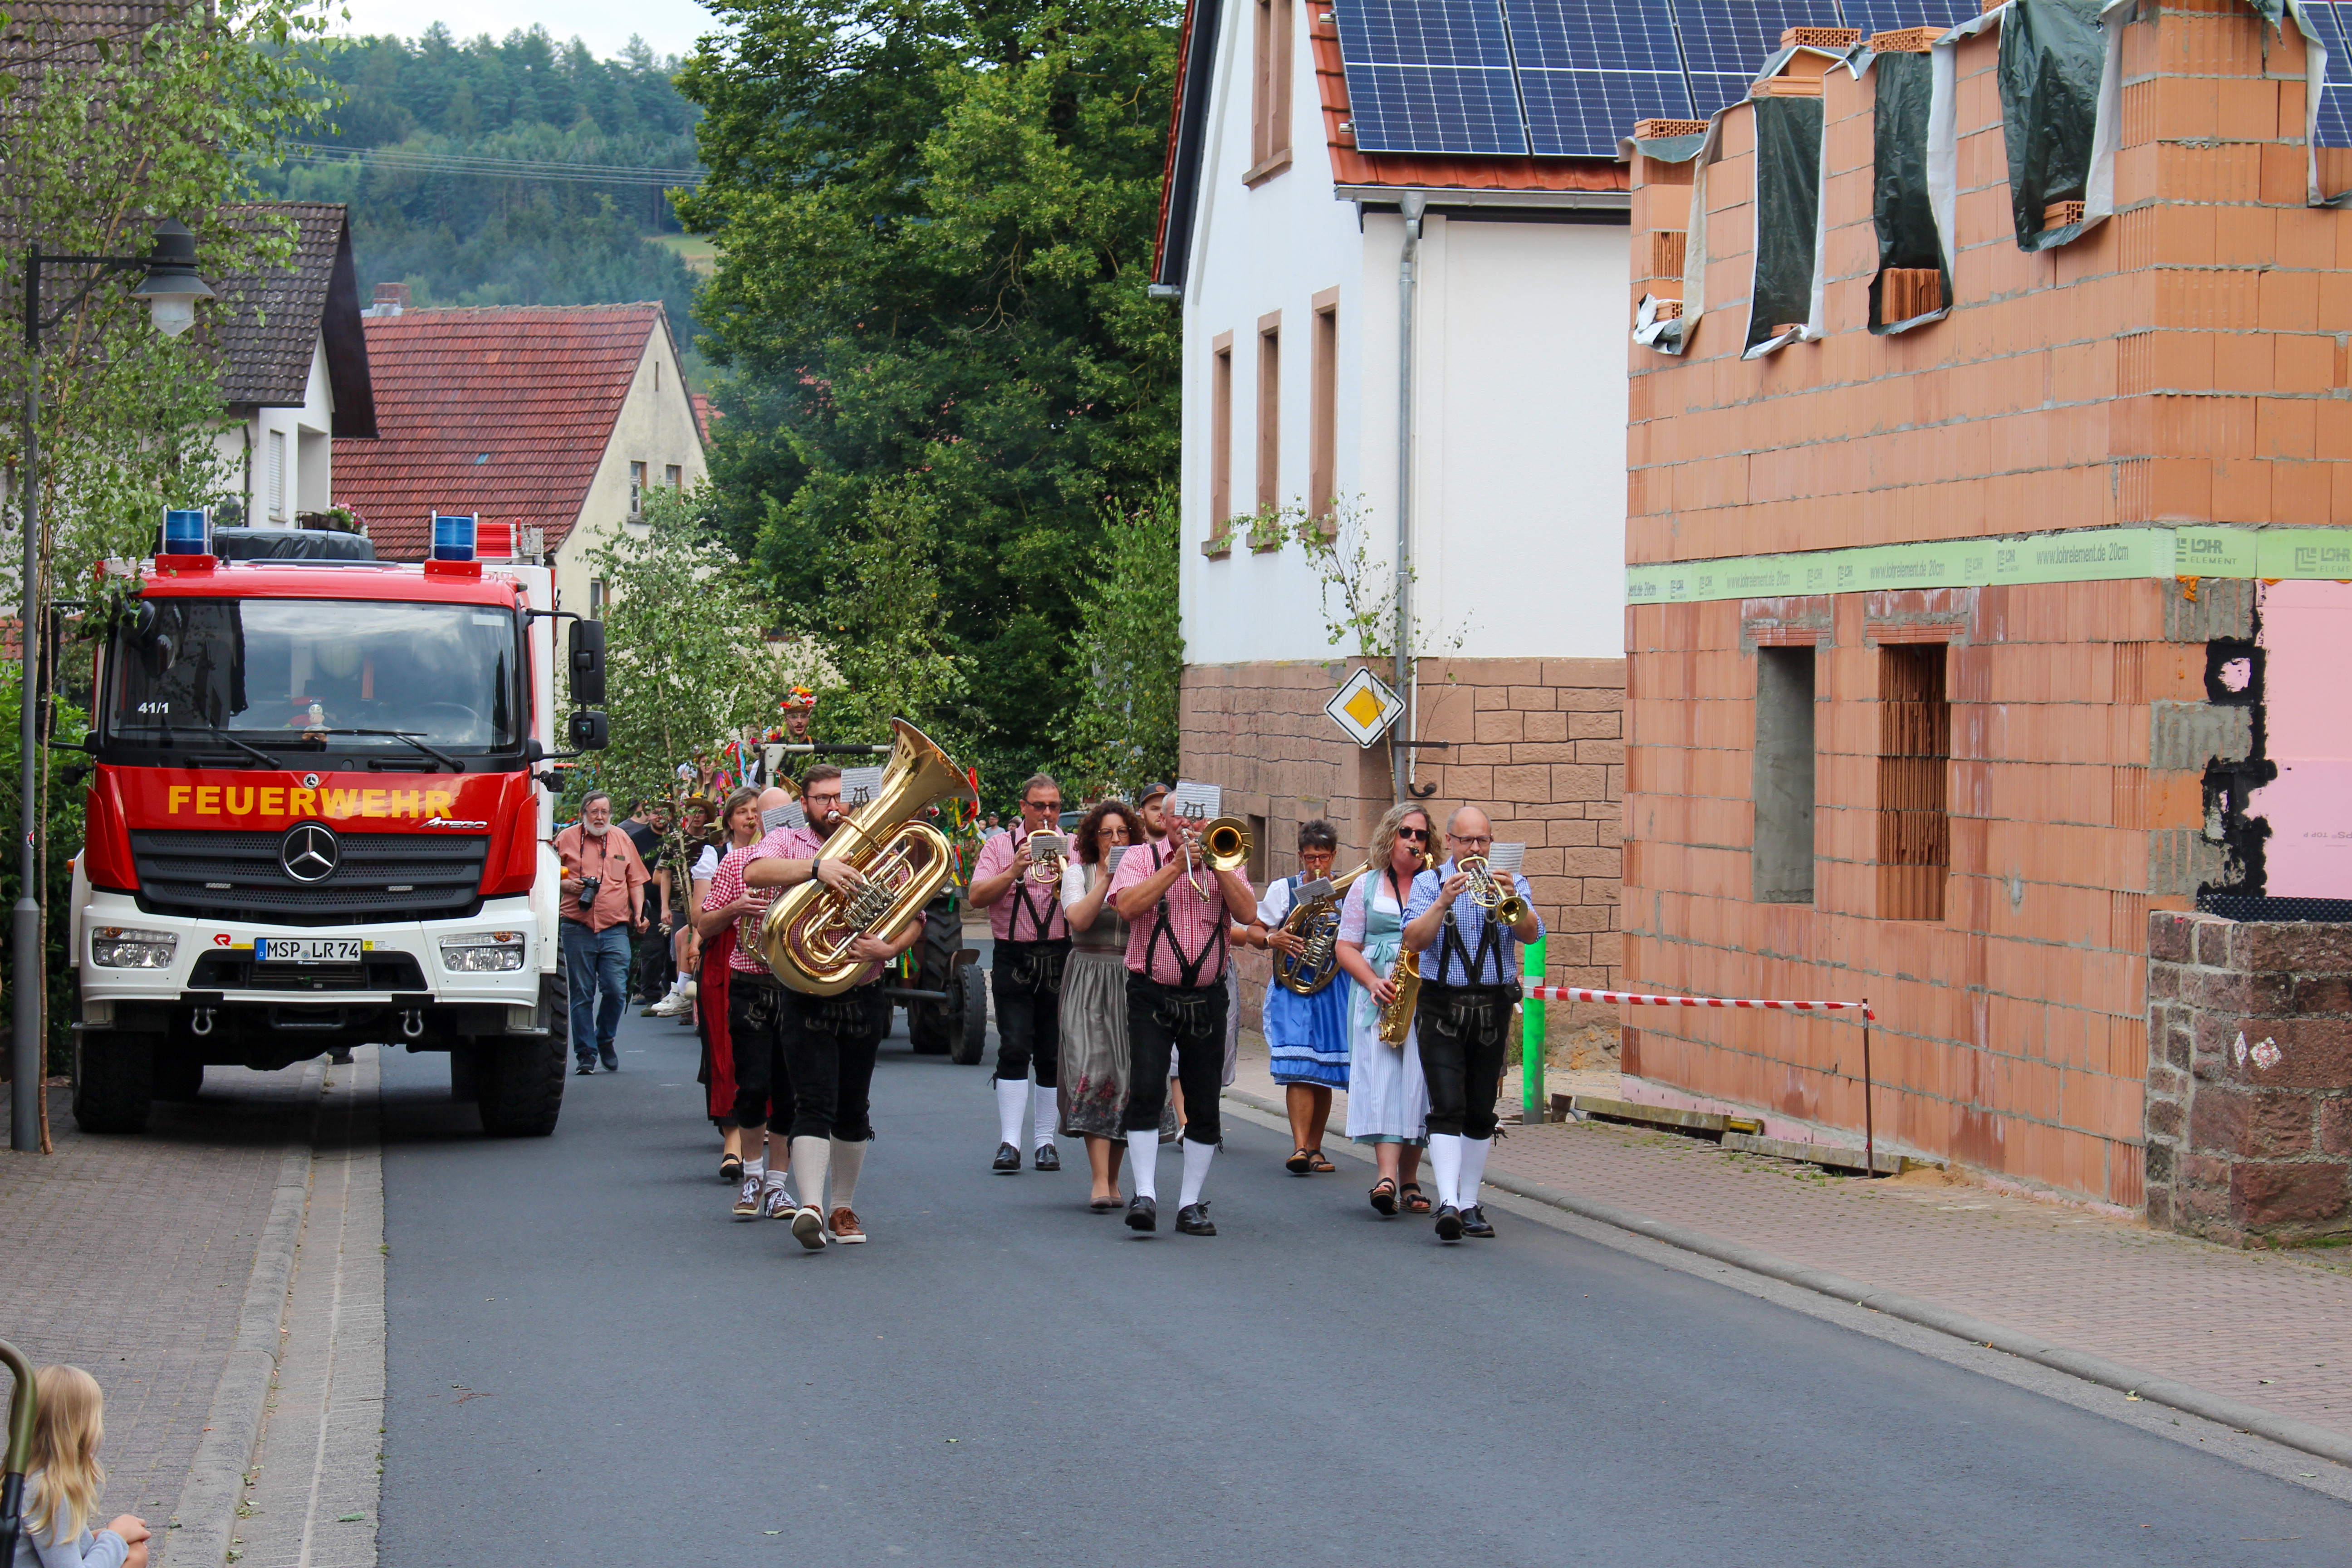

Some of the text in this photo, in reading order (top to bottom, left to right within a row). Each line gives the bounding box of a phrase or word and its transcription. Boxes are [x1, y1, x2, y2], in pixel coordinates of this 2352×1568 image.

[2037, 542, 2128, 565] www.lohrelement.de 20cm
[2191, 538, 2223, 554] LOHR
[2190, 556, 2238, 565] ELEMENT
[2321, 547, 2351, 562] LOHR
[1929, 559, 1945, 576] 20cm
[1777, 570, 1790, 586] 20cm
[138, 702, 169, 714] 41/1
[168, 785, 454, 819] FEUERWEHR
[267, 942, 300, 957] MSP
[313, 942, 333, 958] LR
[338, 943, 359, 958] 74
